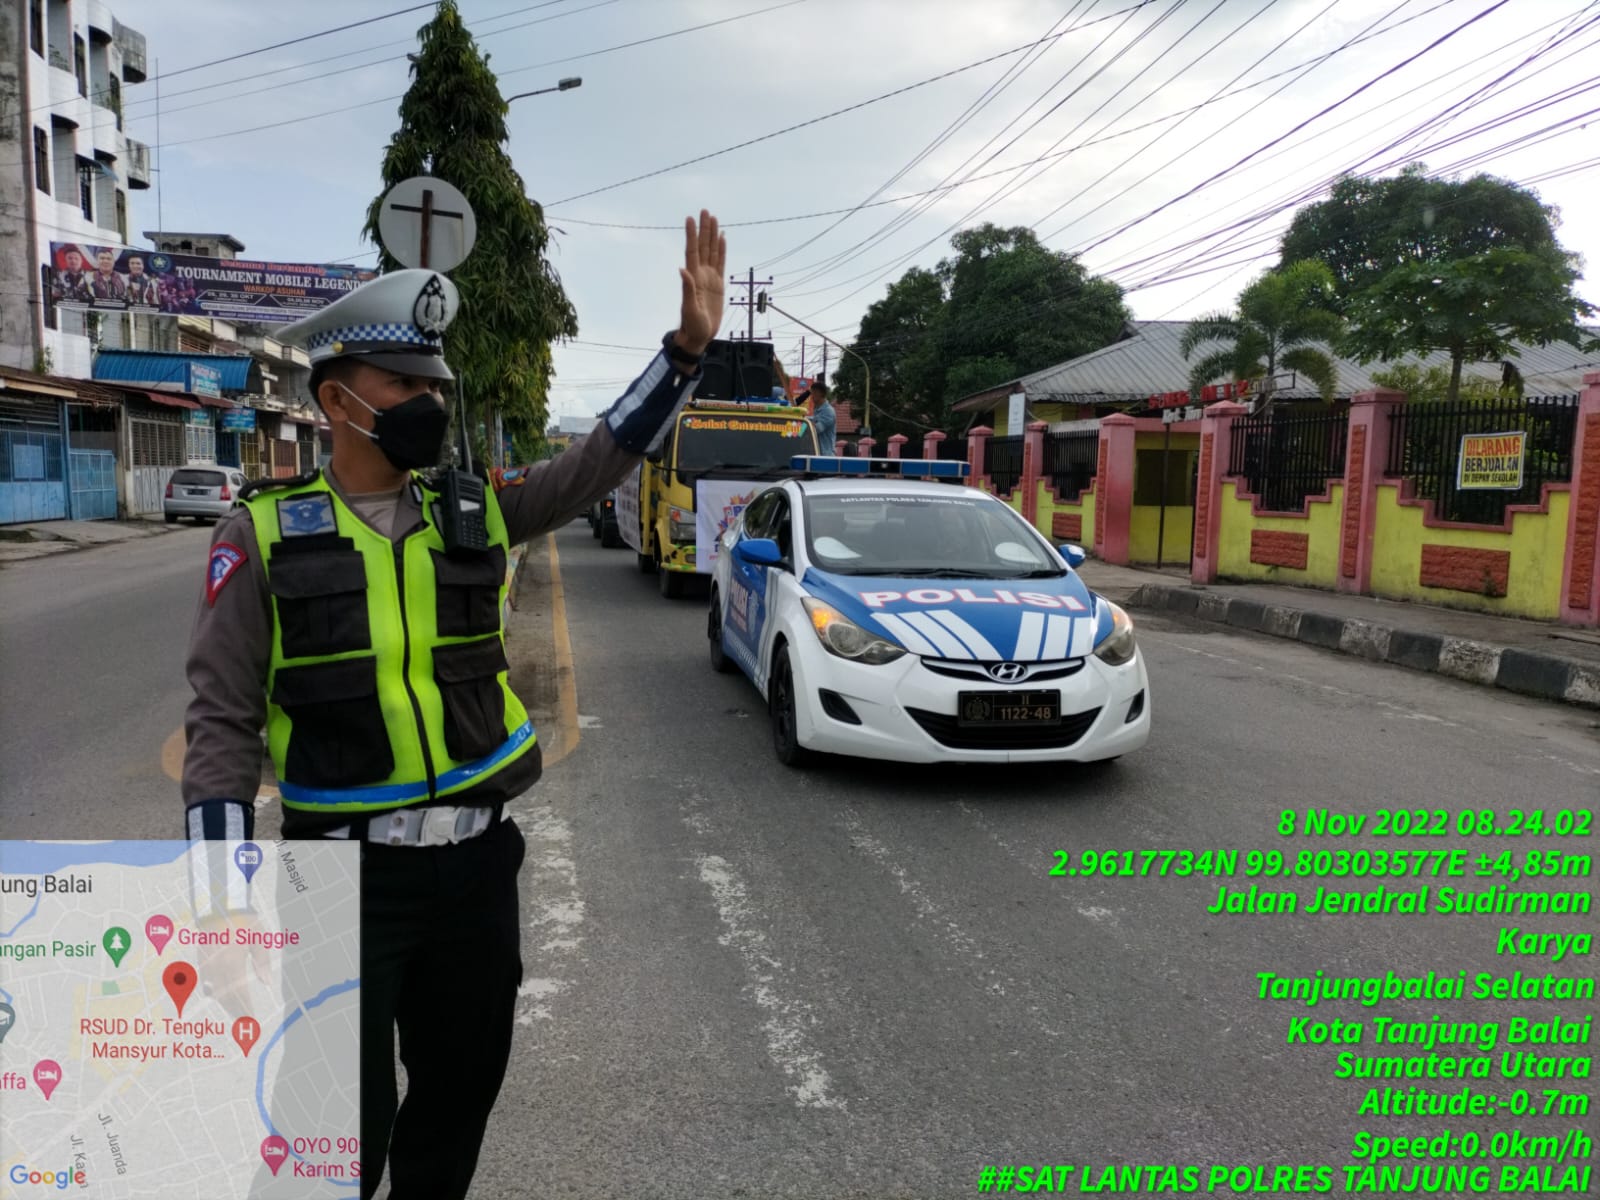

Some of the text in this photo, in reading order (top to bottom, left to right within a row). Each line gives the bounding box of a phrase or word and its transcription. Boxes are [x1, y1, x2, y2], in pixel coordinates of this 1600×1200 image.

[176, 266, 262, 284] TOURNAMENT
[265, 273, 312, 288] MOBILE
[243, 284, 275, 294] WARKOP
[1466, 436, 1520, 456] DILARANG
[1465, 456, 1519, 472] BERJUALAN
[858, 588, 1087, 611] POLISI
